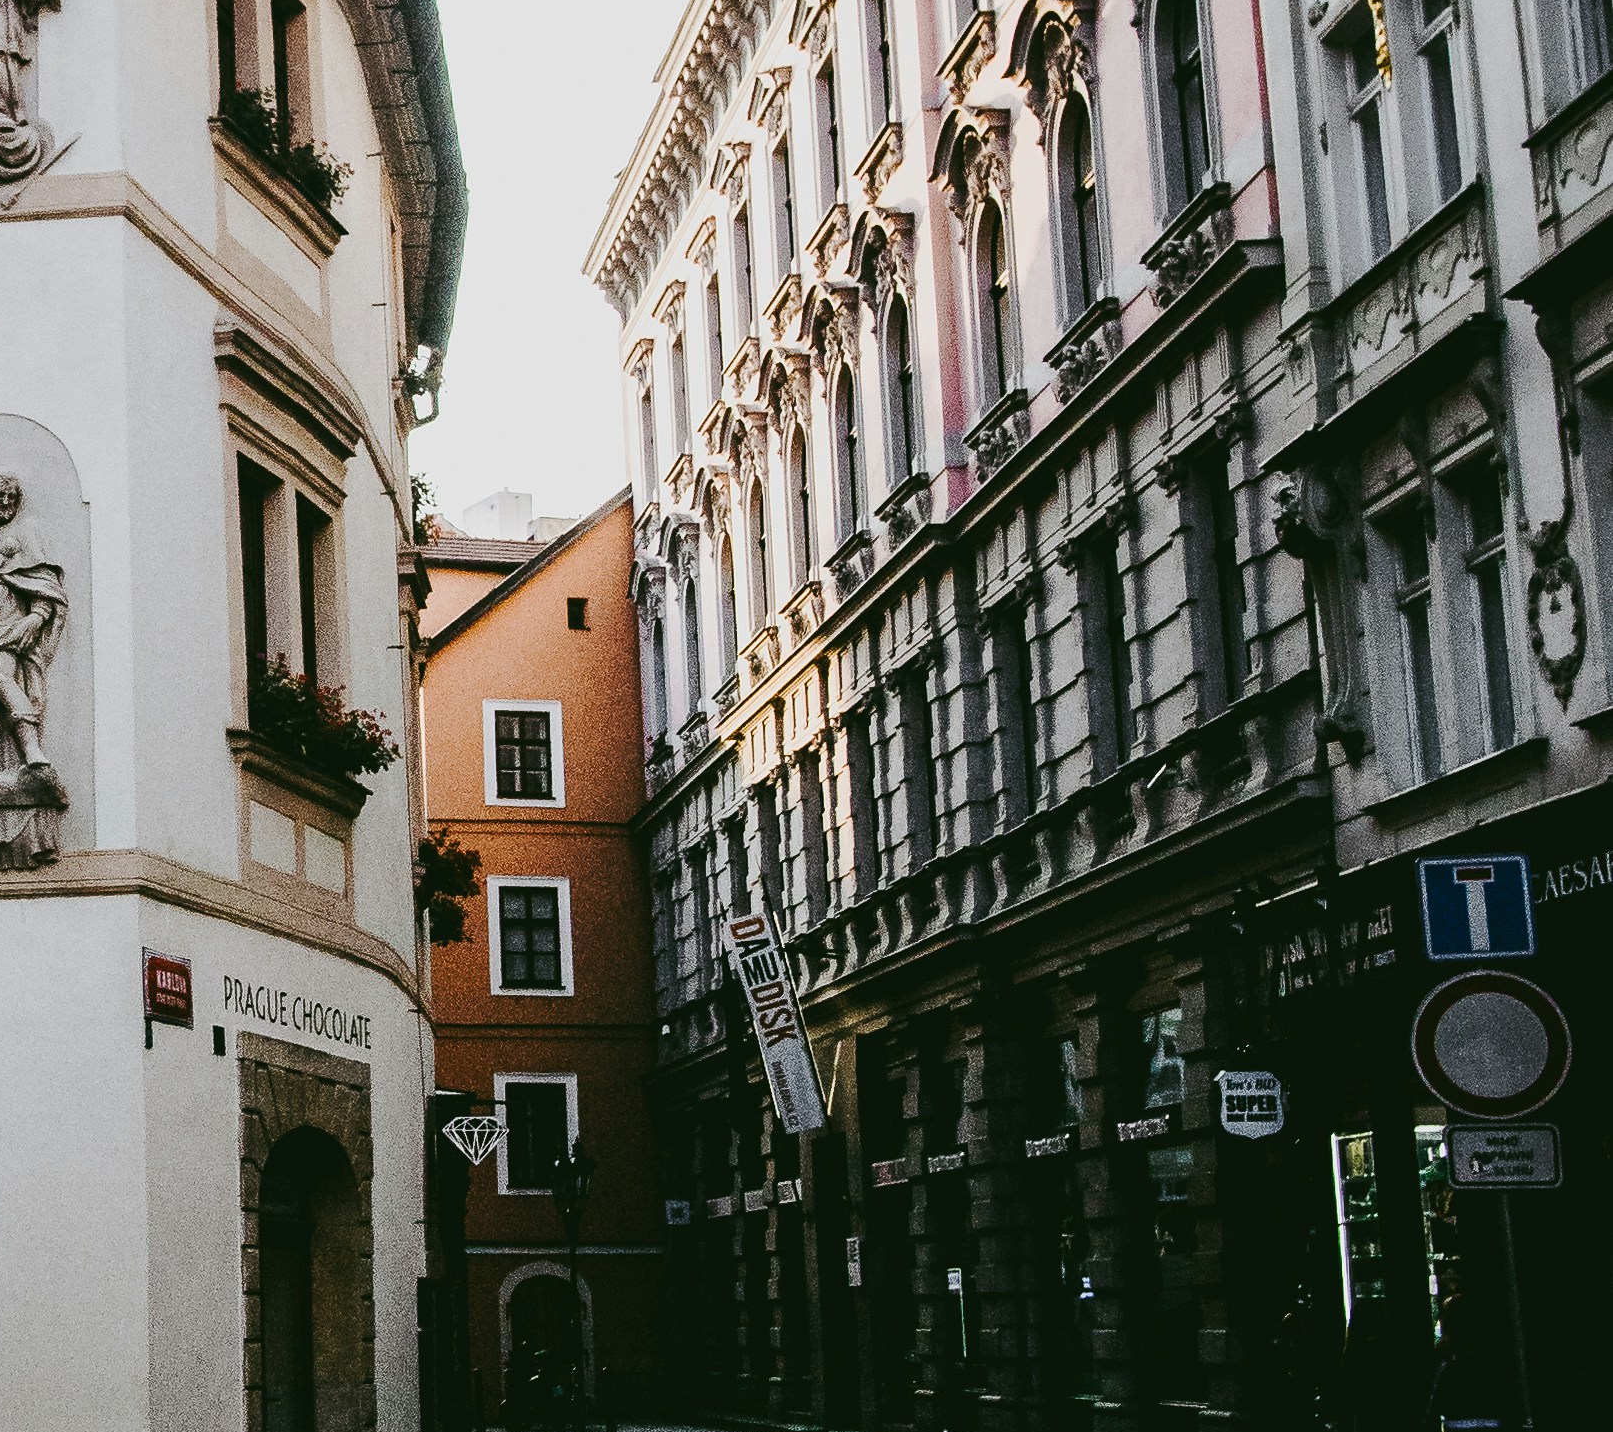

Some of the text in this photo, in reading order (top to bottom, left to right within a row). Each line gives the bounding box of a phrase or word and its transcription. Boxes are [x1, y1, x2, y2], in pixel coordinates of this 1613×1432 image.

[224, 975, 371, 1049] PRAGUE CHOCOLATE
[1226, 1095, 1277, 1112] SUPER
